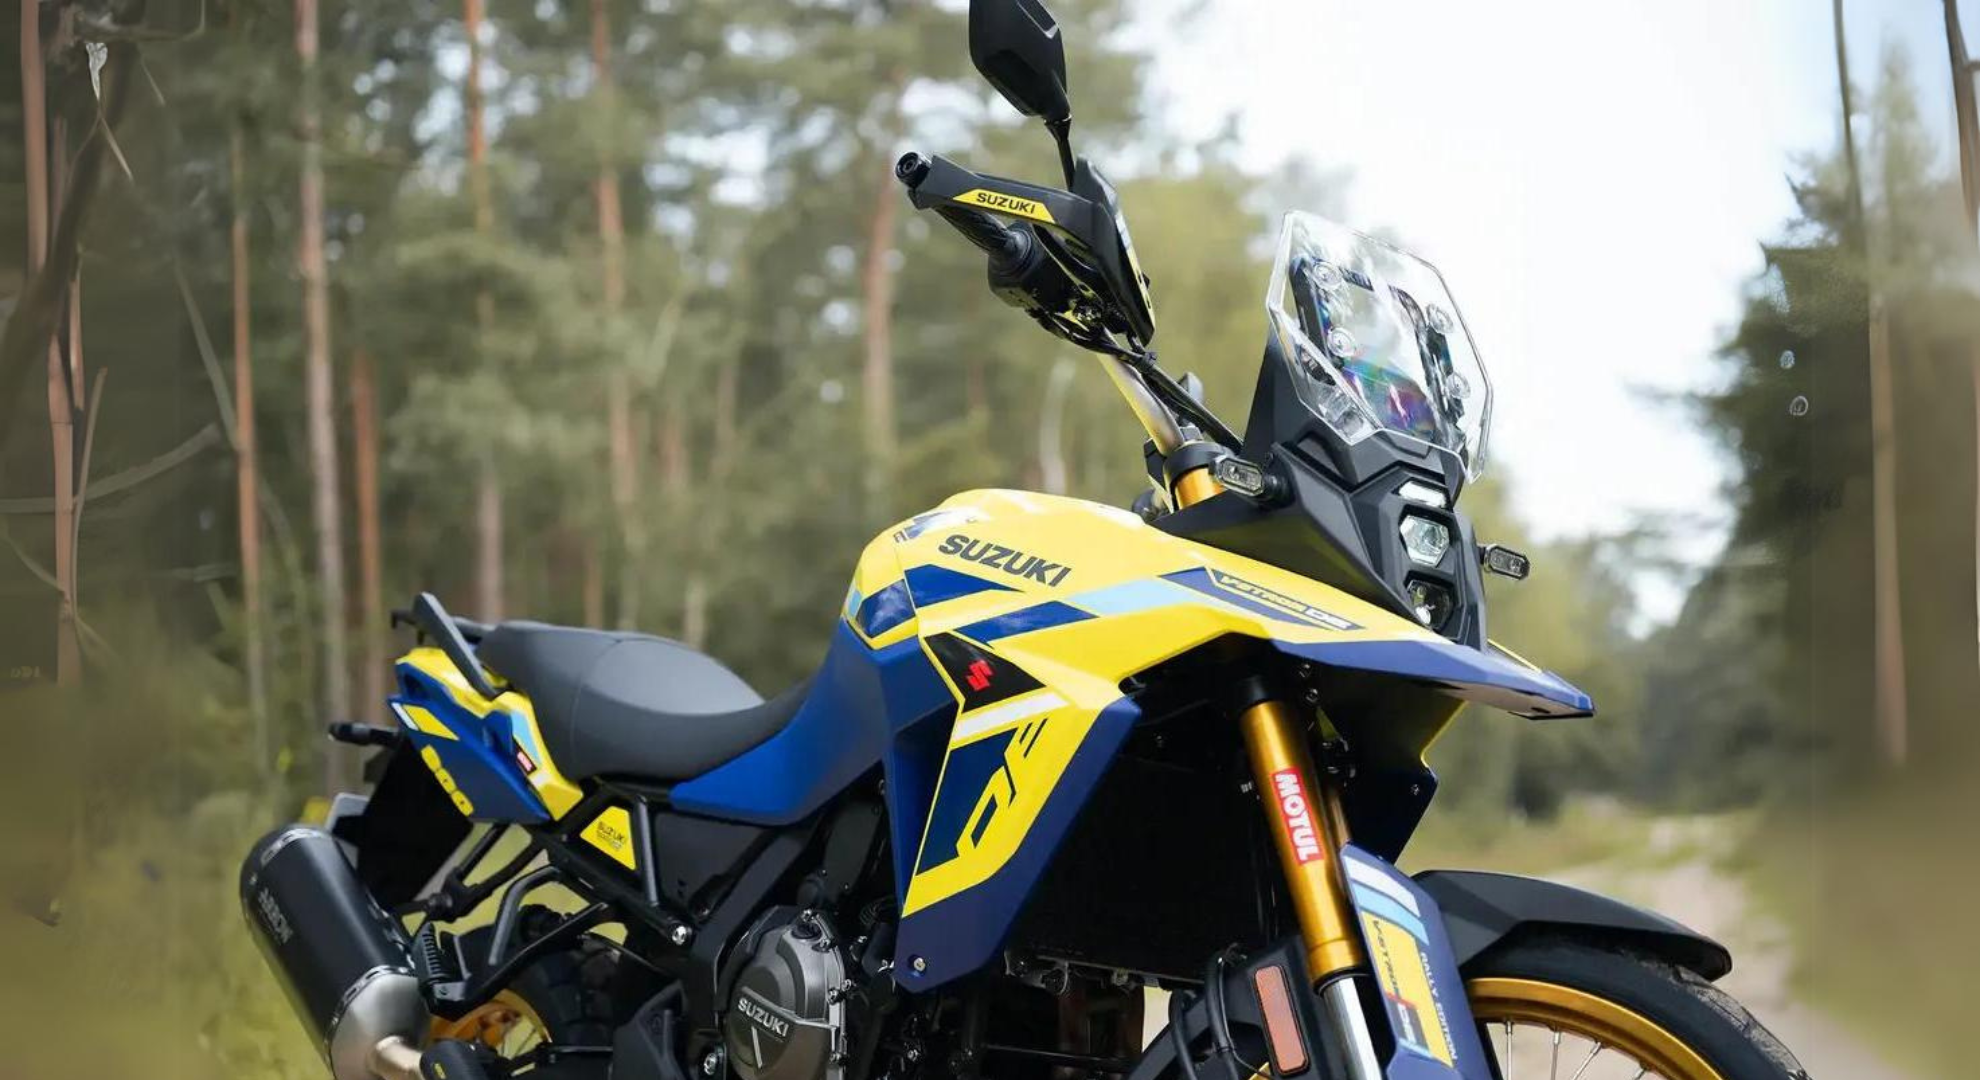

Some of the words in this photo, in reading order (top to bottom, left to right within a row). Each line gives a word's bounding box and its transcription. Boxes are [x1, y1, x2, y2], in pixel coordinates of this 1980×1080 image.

[976, 192, 1036, 215] SUZUKI
[937, 534, 1072, 588] SUZUKI
[1275, 774, 1320, 861] MOTUL
[1420, 951, 1439, 998] RALLY
[737, 998, 790, 1037] SUZUKI
[1435, 1001, 1458, 1061] EDITION
